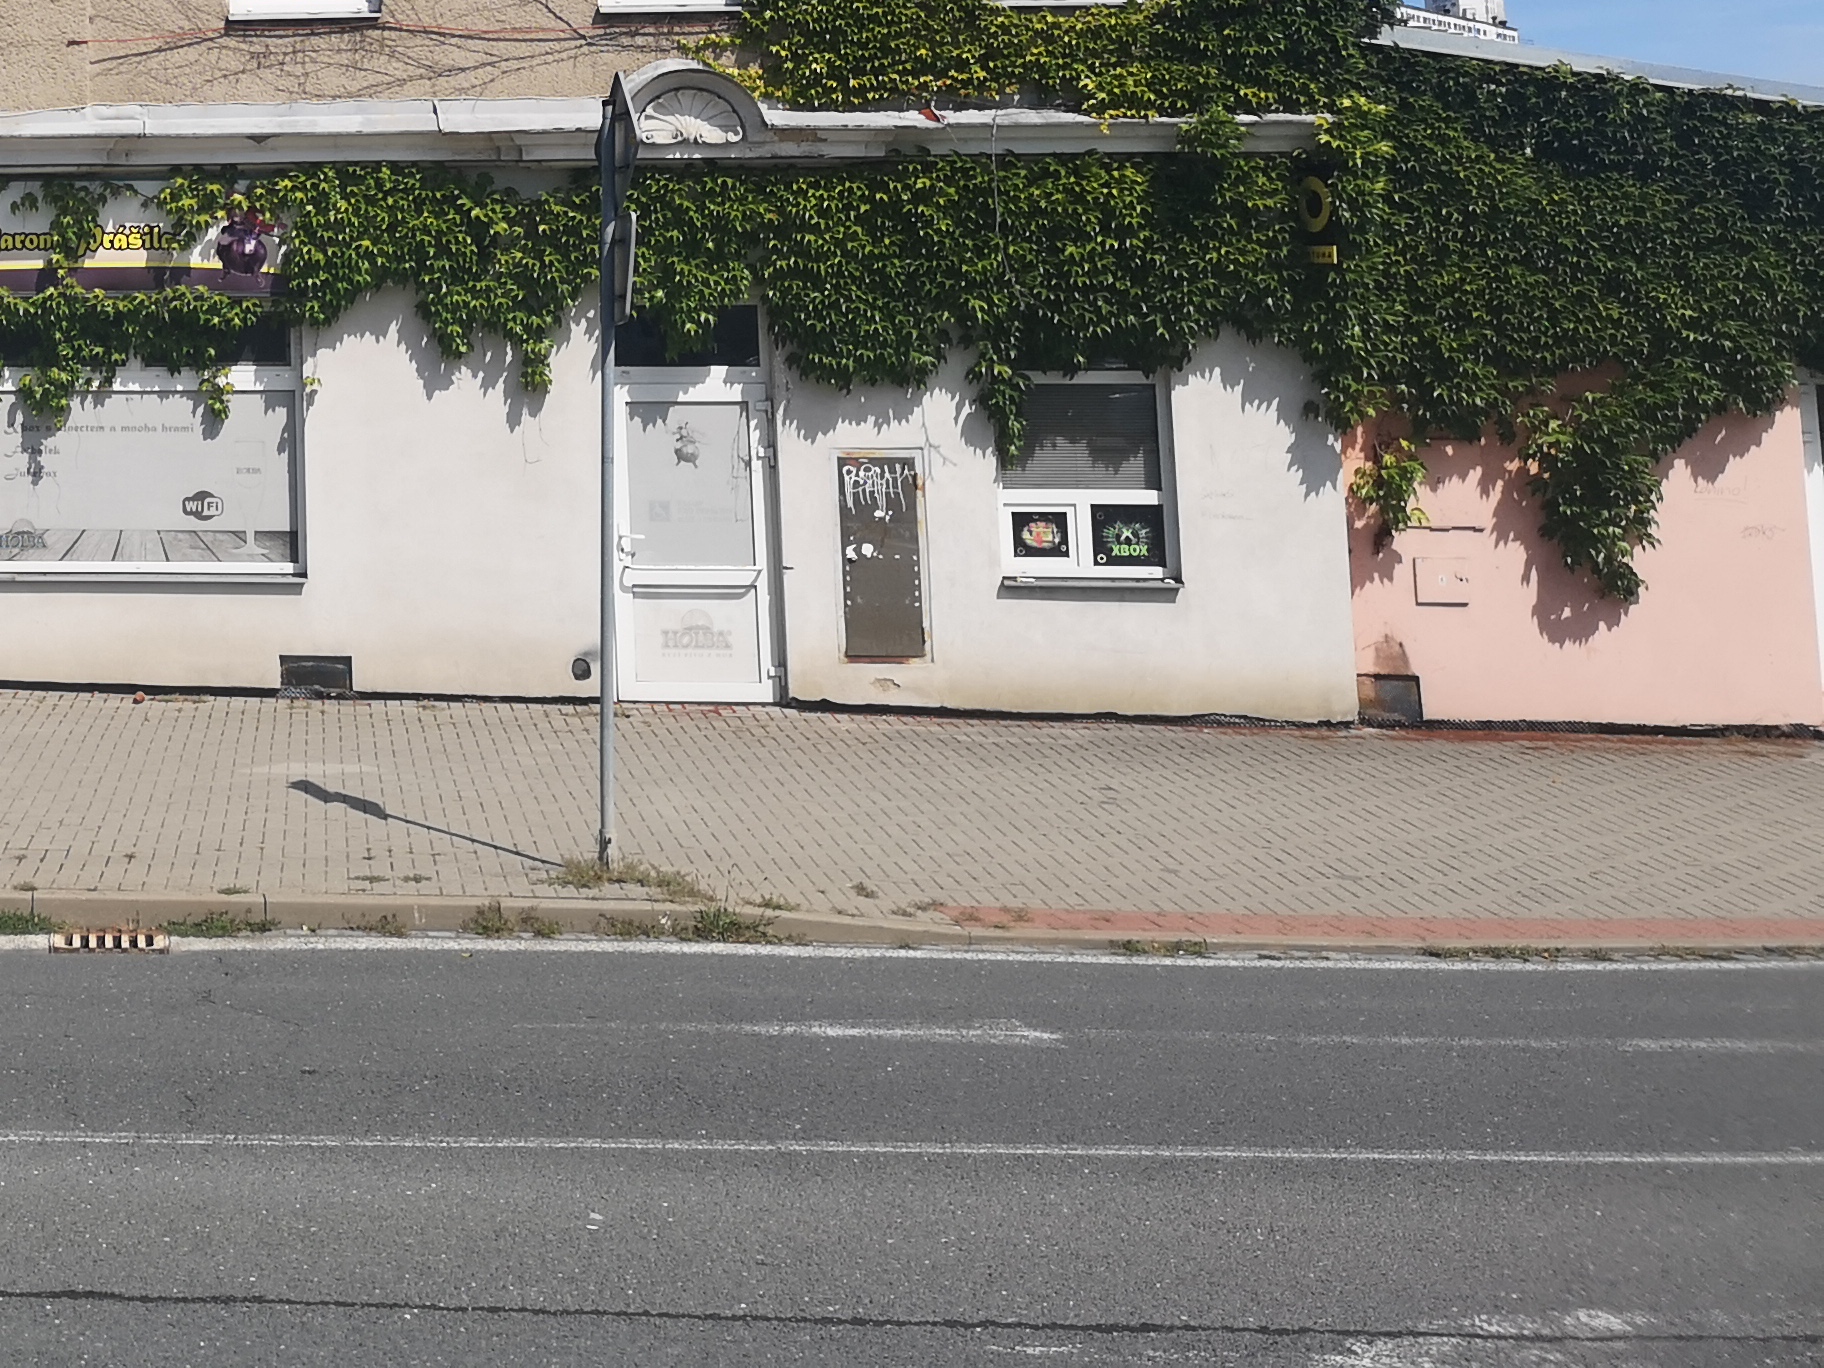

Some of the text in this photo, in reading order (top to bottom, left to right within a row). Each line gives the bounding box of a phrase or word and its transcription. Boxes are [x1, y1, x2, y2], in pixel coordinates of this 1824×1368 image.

[120, 423, 157, 432] mnoha
[161, 423, 194, 432] hrami
[1111, 544, 1149, 556] XBOX
[661, 630, 733, 650] HOLBA
